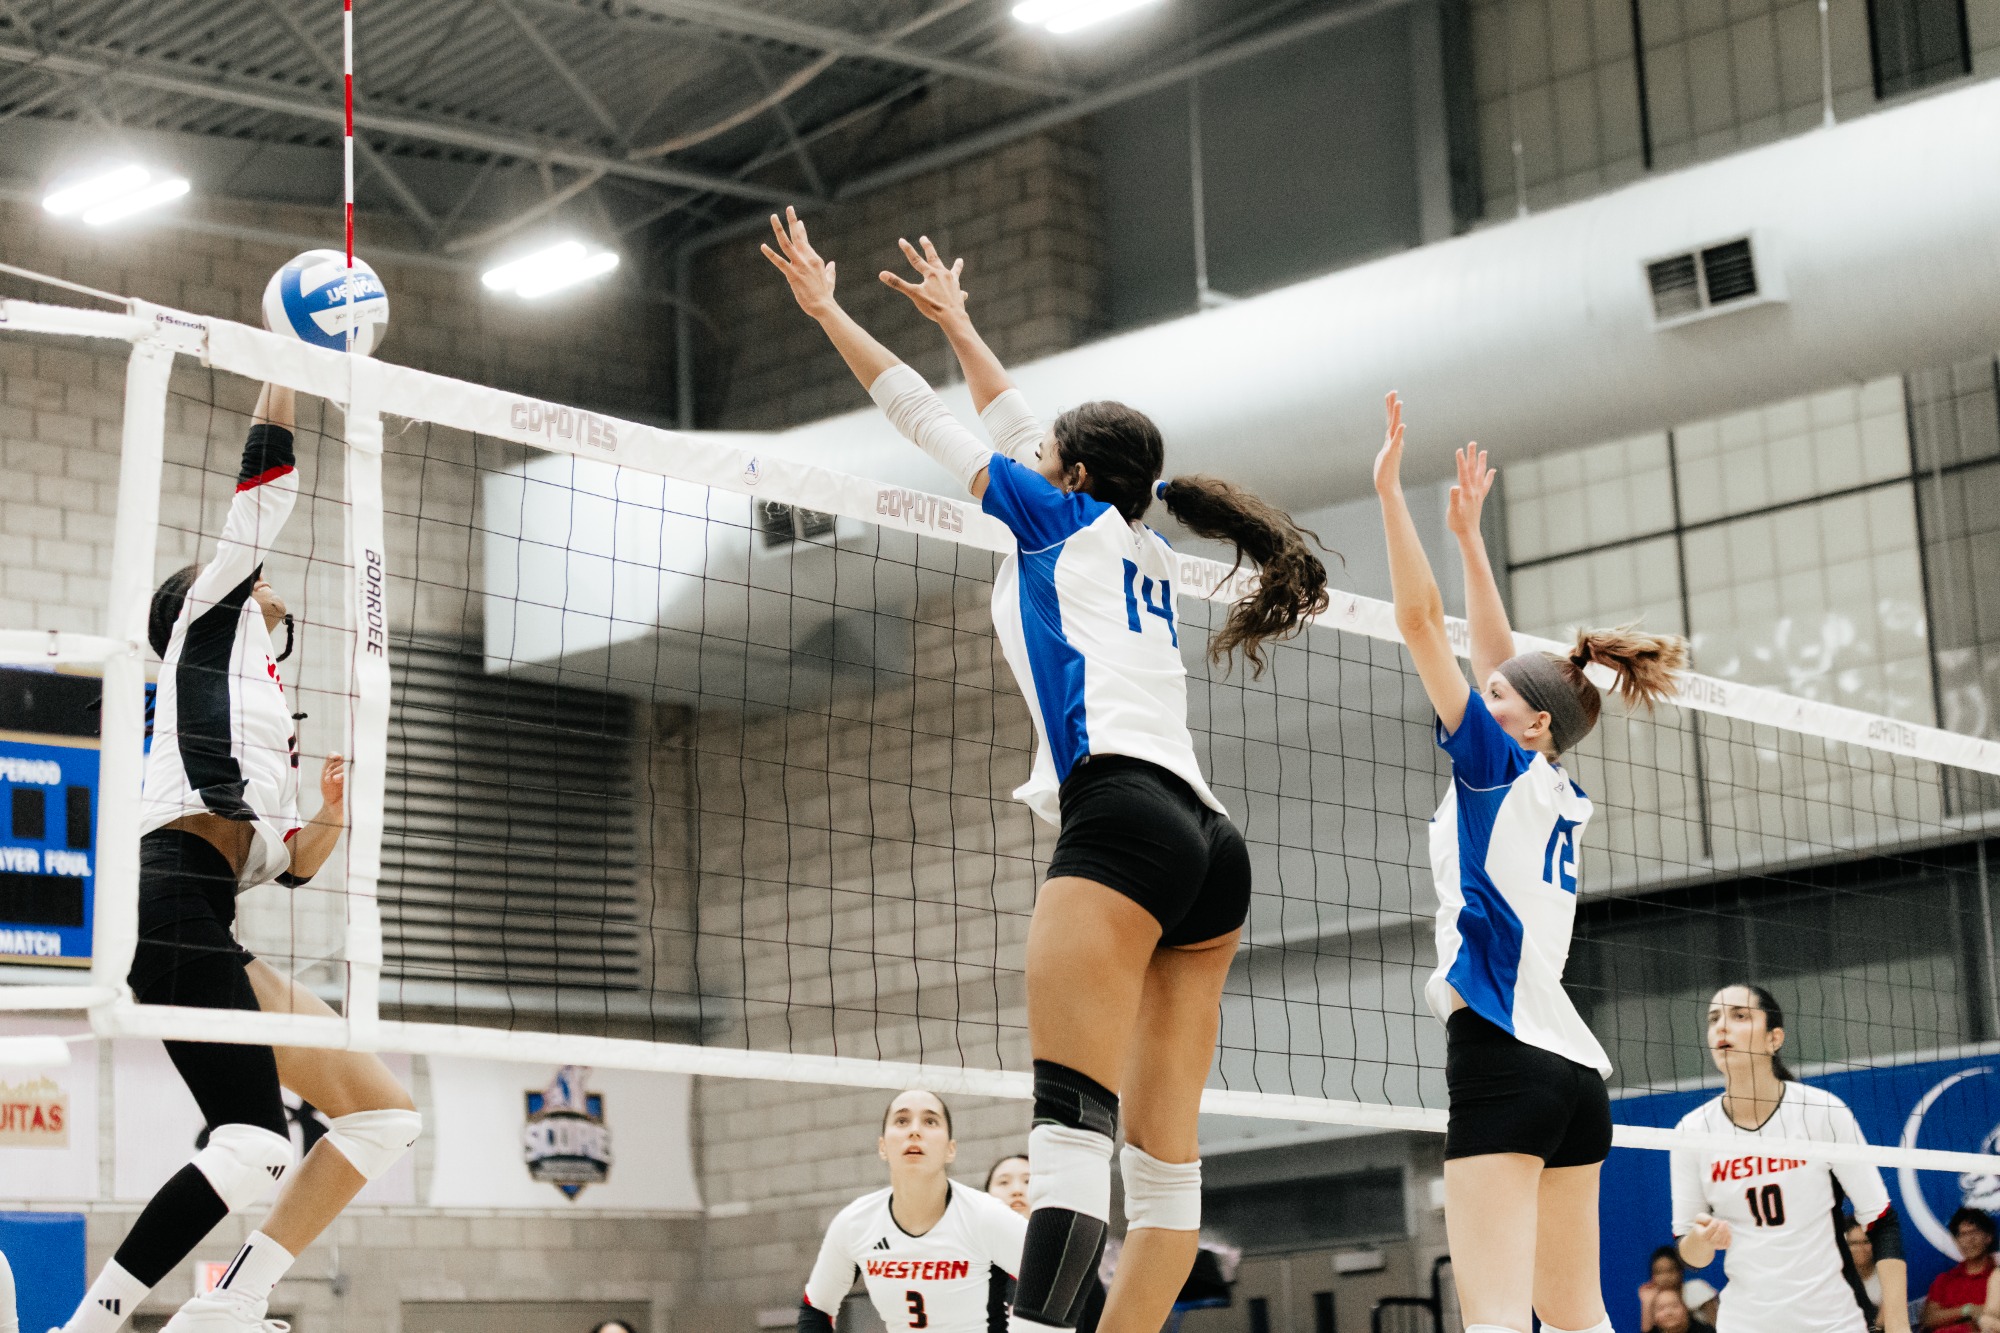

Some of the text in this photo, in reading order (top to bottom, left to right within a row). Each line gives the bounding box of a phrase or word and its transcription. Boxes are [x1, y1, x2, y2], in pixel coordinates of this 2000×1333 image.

[165, 315, 206, 331] Senoh
[511, 402, 618, 452] COYOTES
[877, 490, 964, 534] COYOTES
[365, 549, 383, 658] BOARDEE
[1122, 558, 1178, 649] 14
[0, 756, 60, 785] PERIOD
[44, 849, 92, 877] FOUL
[1543, 813, 1582, 895] 12
[0, 928, 61, 956] MATCH
[1745, 1183, 1785, 1226] 10
[867, 1259, 969, 1280] WESTERN
[906, 1290, 928, 1329] 3
